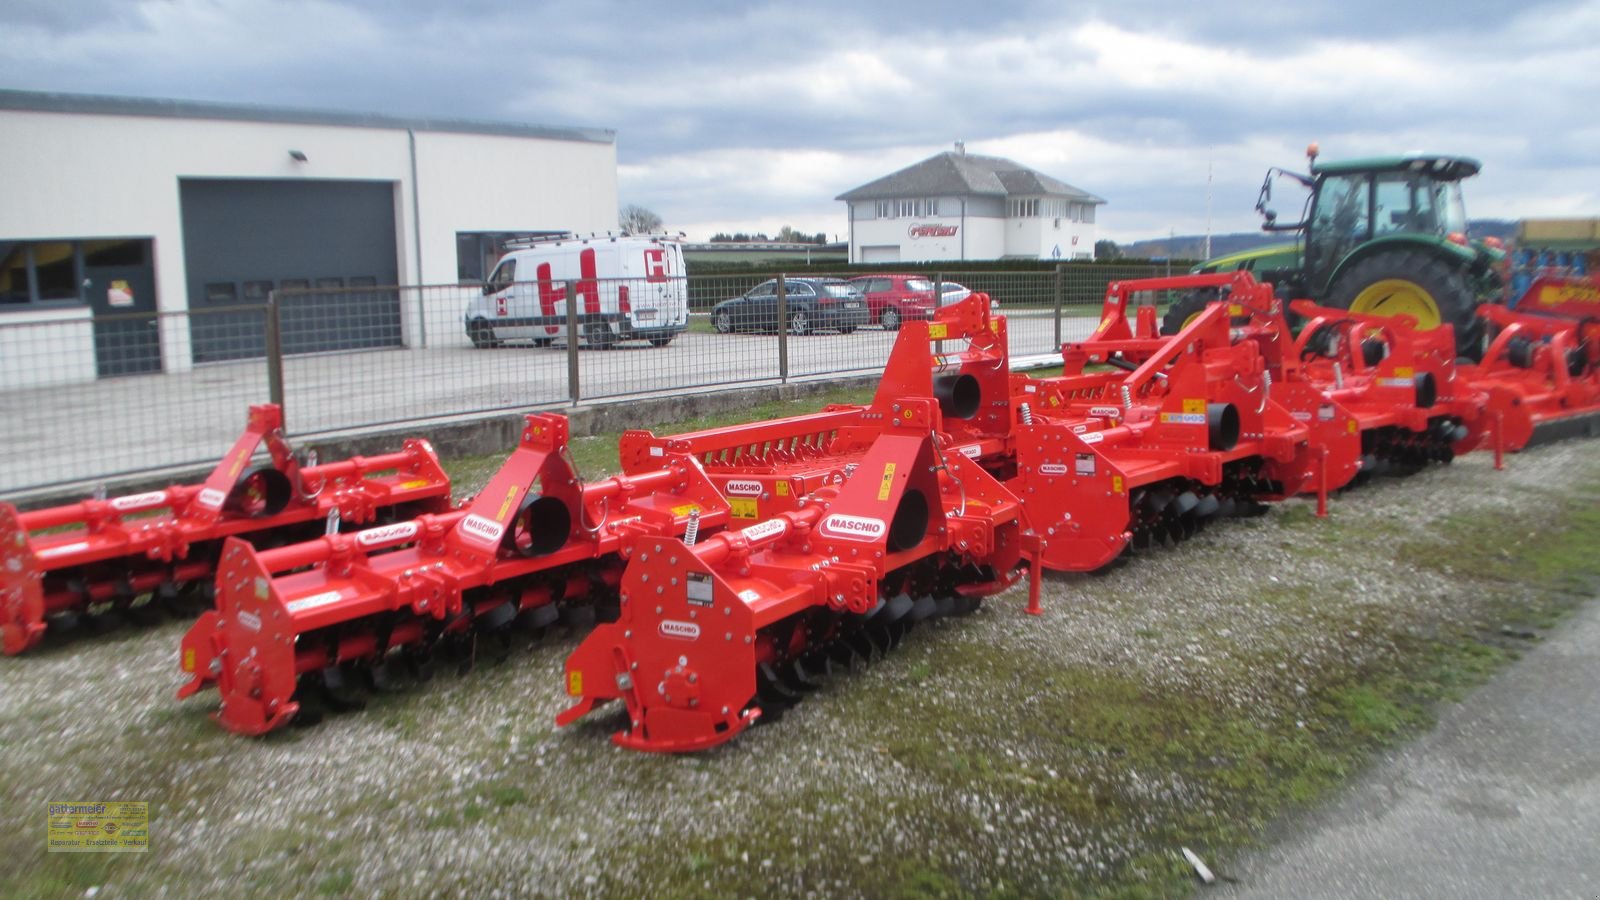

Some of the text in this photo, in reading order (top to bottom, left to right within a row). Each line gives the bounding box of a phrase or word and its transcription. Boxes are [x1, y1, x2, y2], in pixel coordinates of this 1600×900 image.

[728, 483, 761, 492] MASCHIO
[363, 526, 413, 541] MASCHIO
[466, 517, 500, 537] MASCHIO
[829, 518, 881, 534] MASCHIO
[663, 623, 697, 634] MASCHIO
